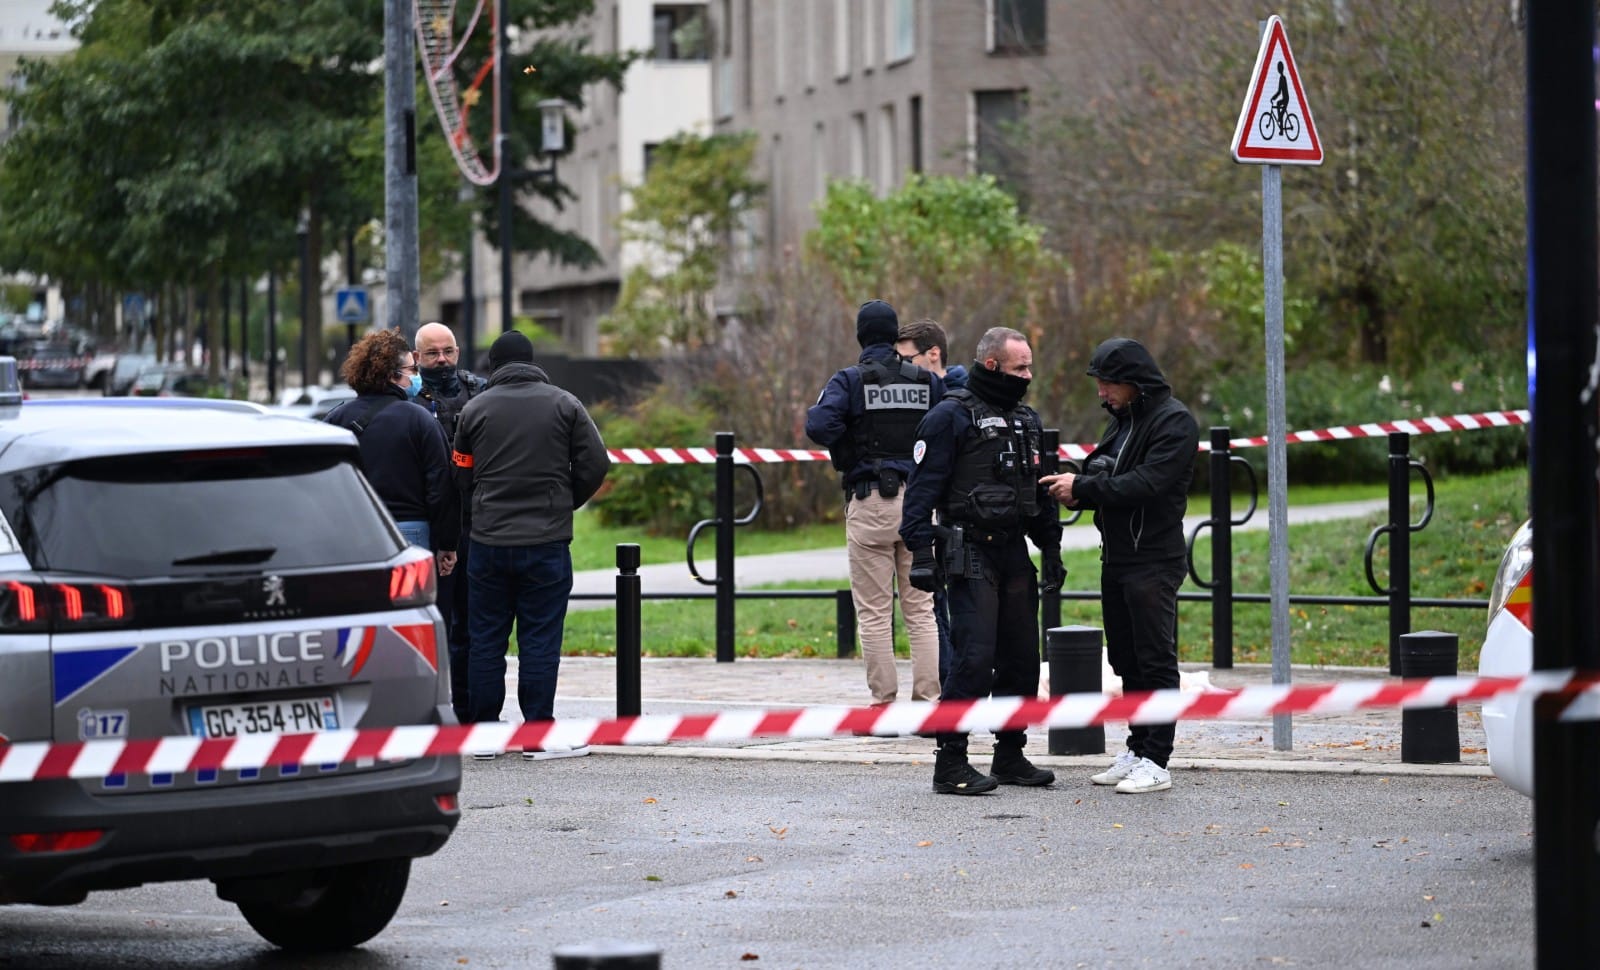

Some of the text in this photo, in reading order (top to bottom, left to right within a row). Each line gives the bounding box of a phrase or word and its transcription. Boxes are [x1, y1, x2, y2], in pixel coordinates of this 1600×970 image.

[867, 388, 928, 405] POLICE
[160, 630, 324, 673] POLICE
[159, 666, 325, 696] NATIONALE
[99, 715, 124, 734] 17
[205, 701, 323, 738] GC-354-PN
